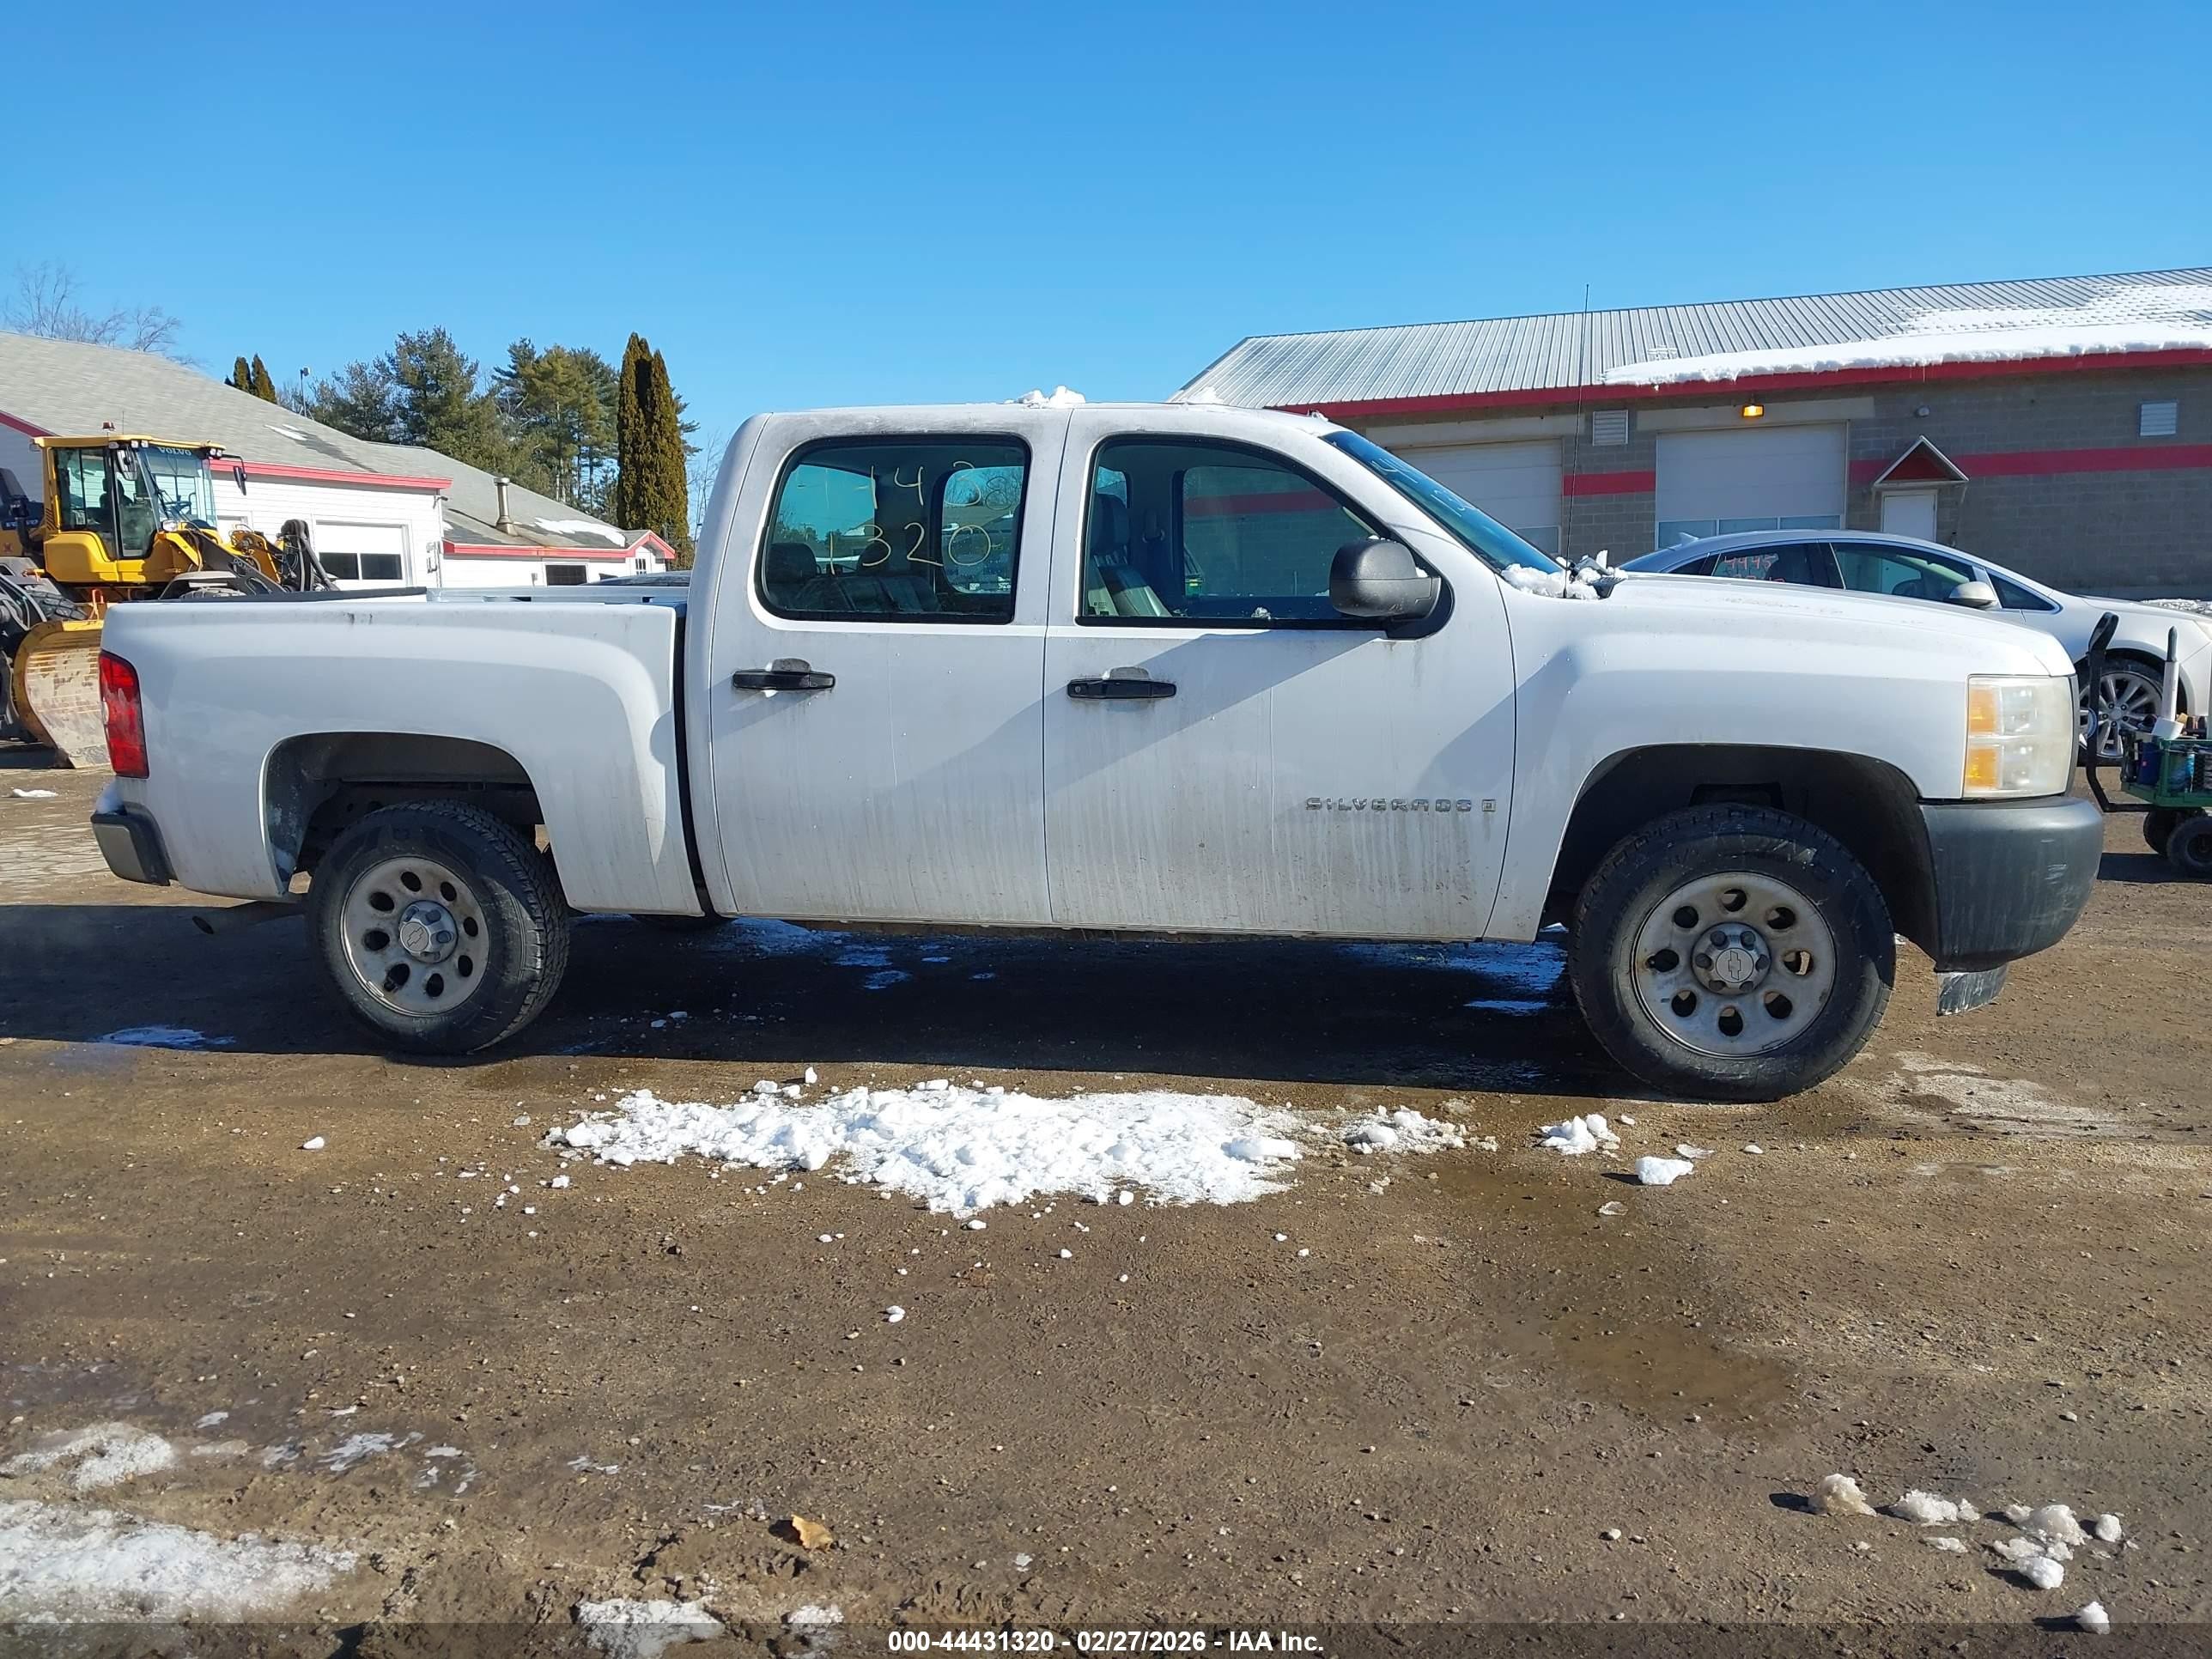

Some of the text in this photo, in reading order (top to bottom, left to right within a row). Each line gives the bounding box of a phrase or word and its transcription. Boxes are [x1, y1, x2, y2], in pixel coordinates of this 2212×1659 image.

[157, 447, 191, 456] VOLVO
[830, 522, 992, 575] 1320
[1305, 797, 1473, 812] SILVERADO
